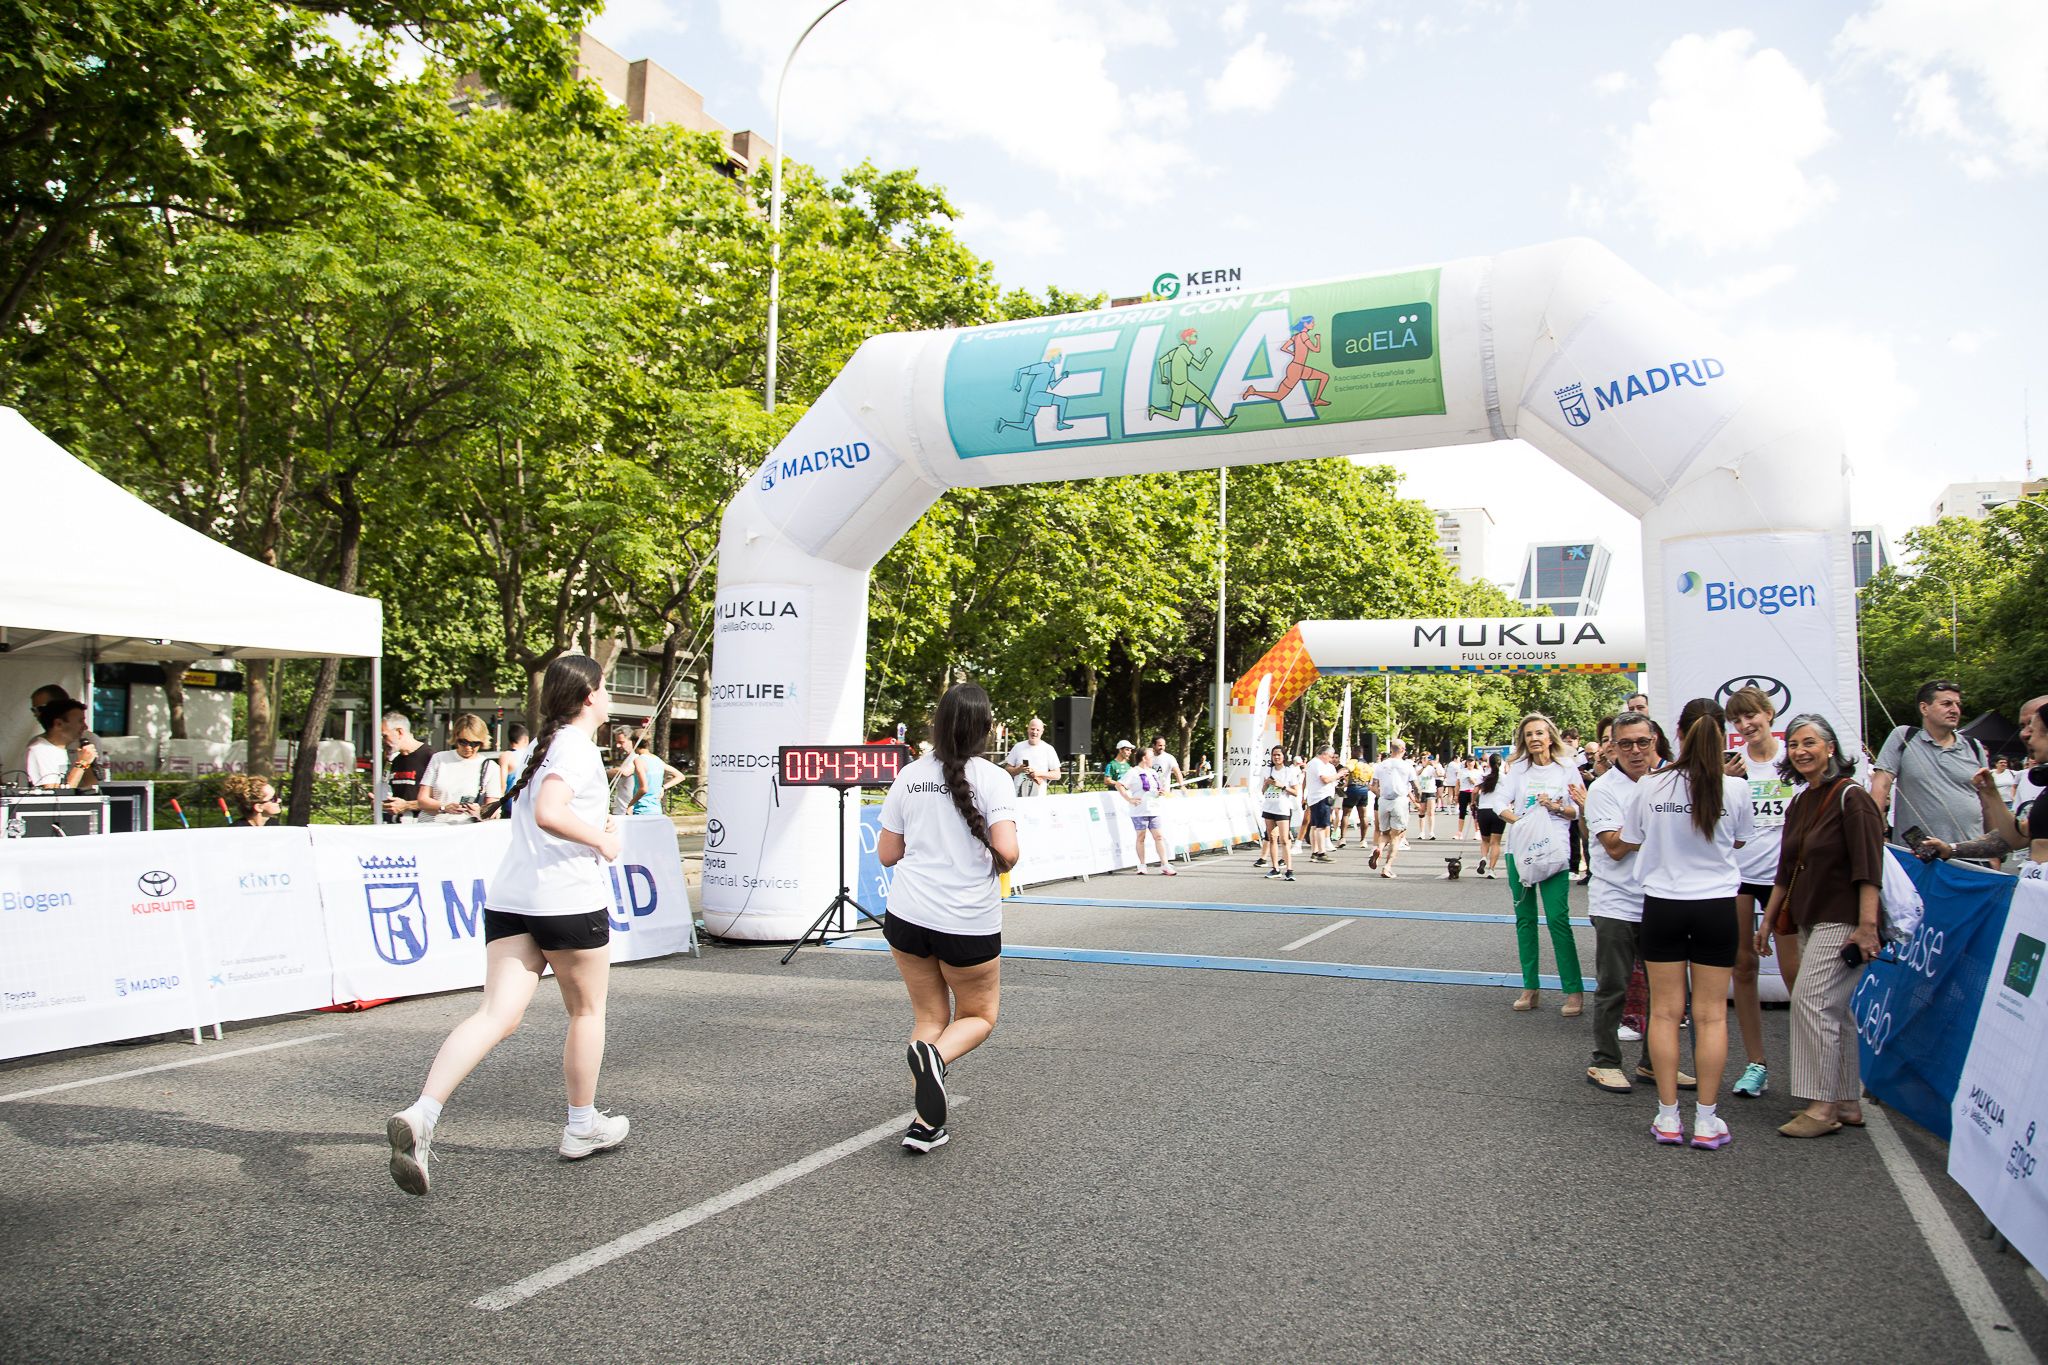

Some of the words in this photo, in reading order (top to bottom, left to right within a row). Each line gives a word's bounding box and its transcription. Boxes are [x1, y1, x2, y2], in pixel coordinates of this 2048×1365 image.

[1186, 267, 1241, 286] KERN
[983, 325, 1050, 340] Carrera
[1053, 305, 1174, 334] MADRID
[1179, 296, 1246, 317] CON
[1250, 289, 1291, 309] LA
[1344, 327, 1418, 355] adELA
[1032, 305, 1318, 446] ELA
[1594, 357, 1726, 412] MADRID
[781, 442, 871, 481] MADRID
[1705, 583, 1816, 616] Biogen
[720, 620, 775, 633] elillaGroup.
[1413, 622, 1606, 648] MUKUA
[1462, 652, 1484, 661] FULL
[1489, 652, 1502, 661] OF
[1506, 651, 1557, 660] COLOURS
[785, 751, 898, 781] 00:43:44
[742, 875, 800, 889] Services
[2, 890, 73, 912] Biogen
[441, 863, 658, 939] MID
[4, 990, 37, 1001] Toyota
[130, 975, 180, 992] MADRID
[1969, 1083, 2006, 1129] MUKUA
